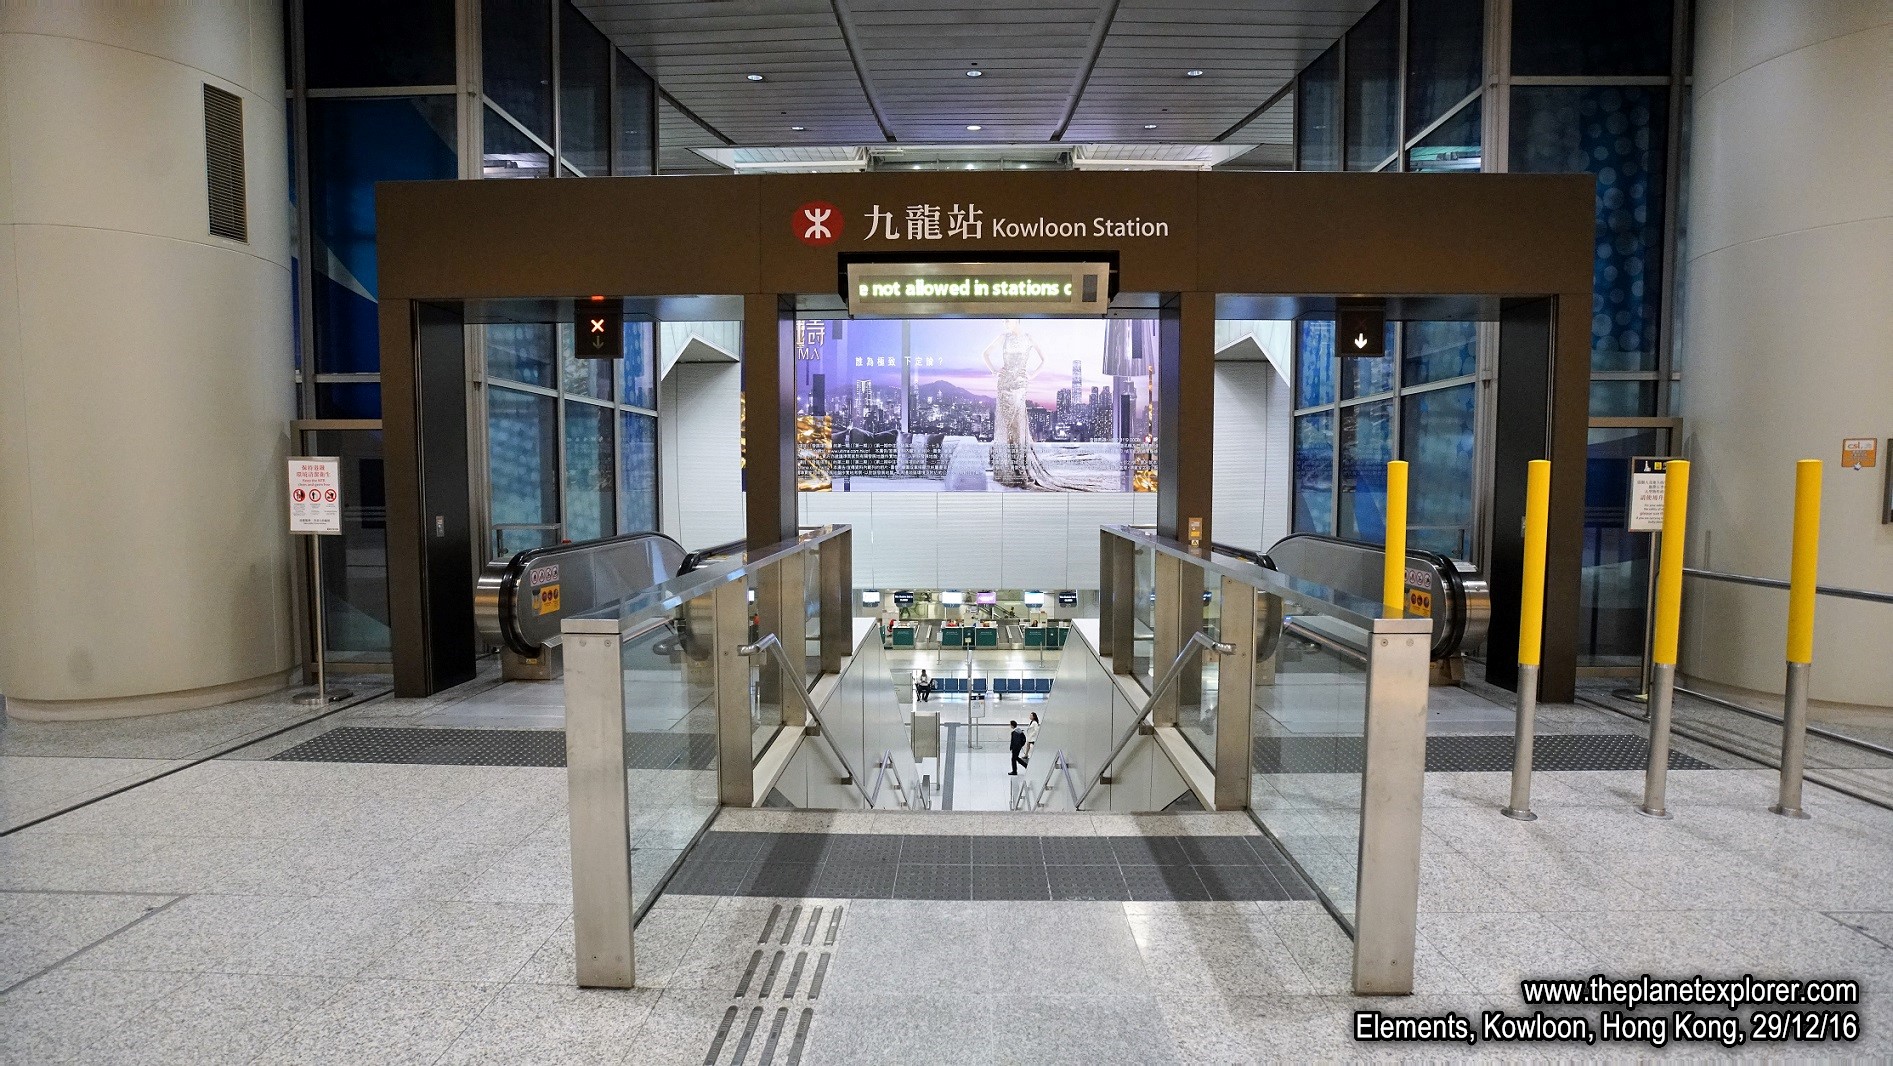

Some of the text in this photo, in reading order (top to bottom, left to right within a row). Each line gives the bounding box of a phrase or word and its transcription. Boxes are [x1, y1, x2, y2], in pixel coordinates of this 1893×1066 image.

[863, 203, 983, 241] 九龍站
[992, 216, 1170, 238] Kowloon Station
[872, 282, 900, 296] not
[905, 278, 970, 296] allowed
[974, 279, 989, 296] in
[992, 279, 1060, 296] stations
